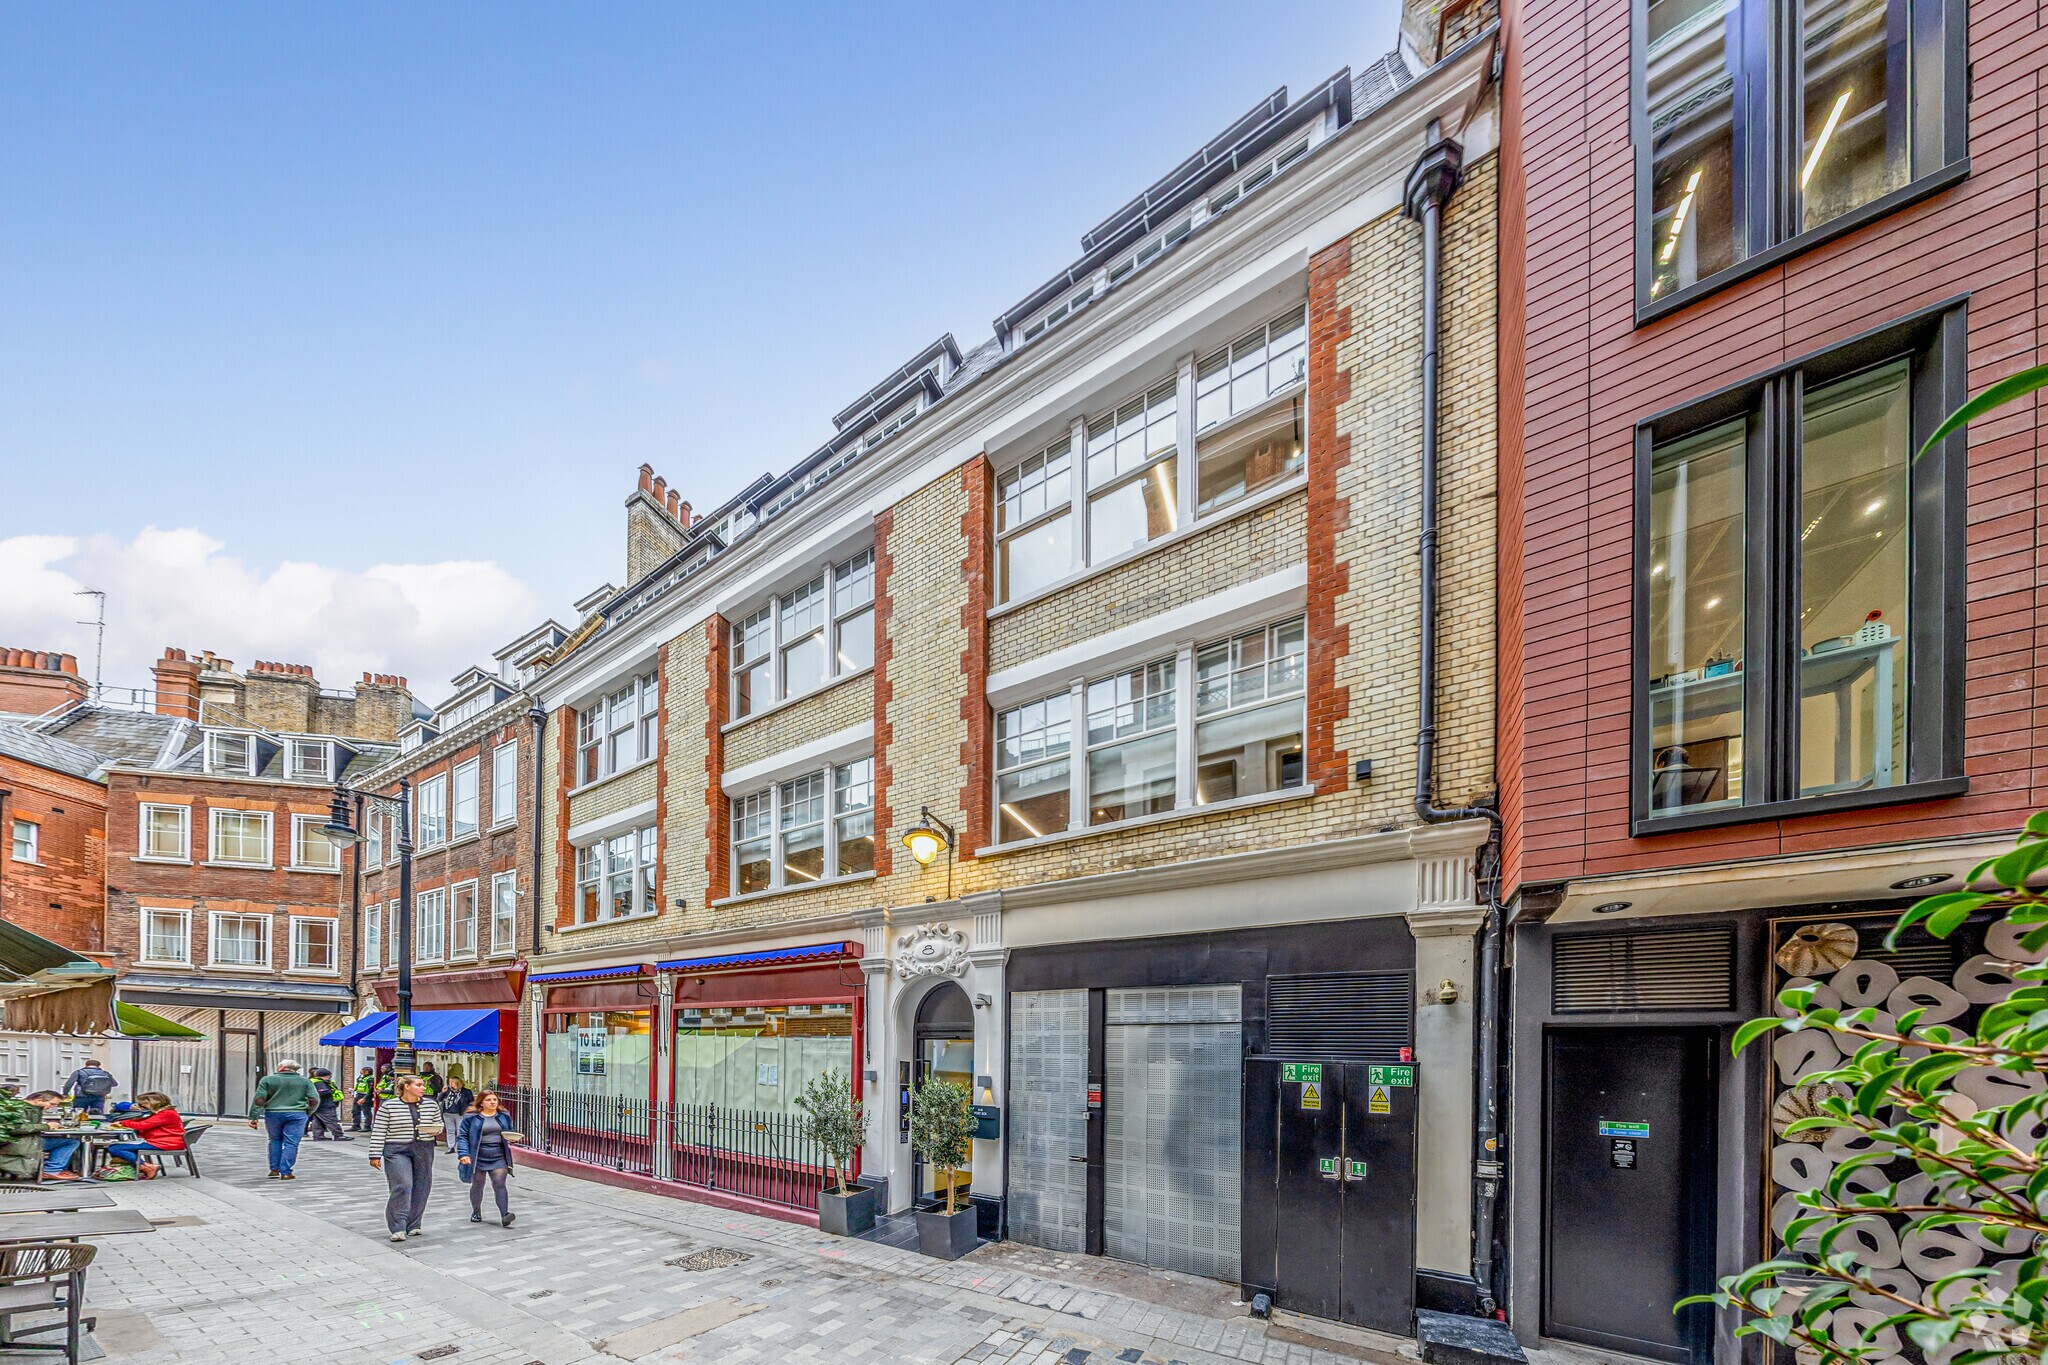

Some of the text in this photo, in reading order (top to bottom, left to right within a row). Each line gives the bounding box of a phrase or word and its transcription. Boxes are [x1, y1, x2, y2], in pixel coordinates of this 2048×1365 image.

[922, 944, 935, 956] 8
[579, 1033, 606, 1047] TO LET
[1302, 1065, 1320, 1073] Fire
[1390, 1067, 1410, 1076] Fire
[1390, 1077, 1410, 1085] exit
